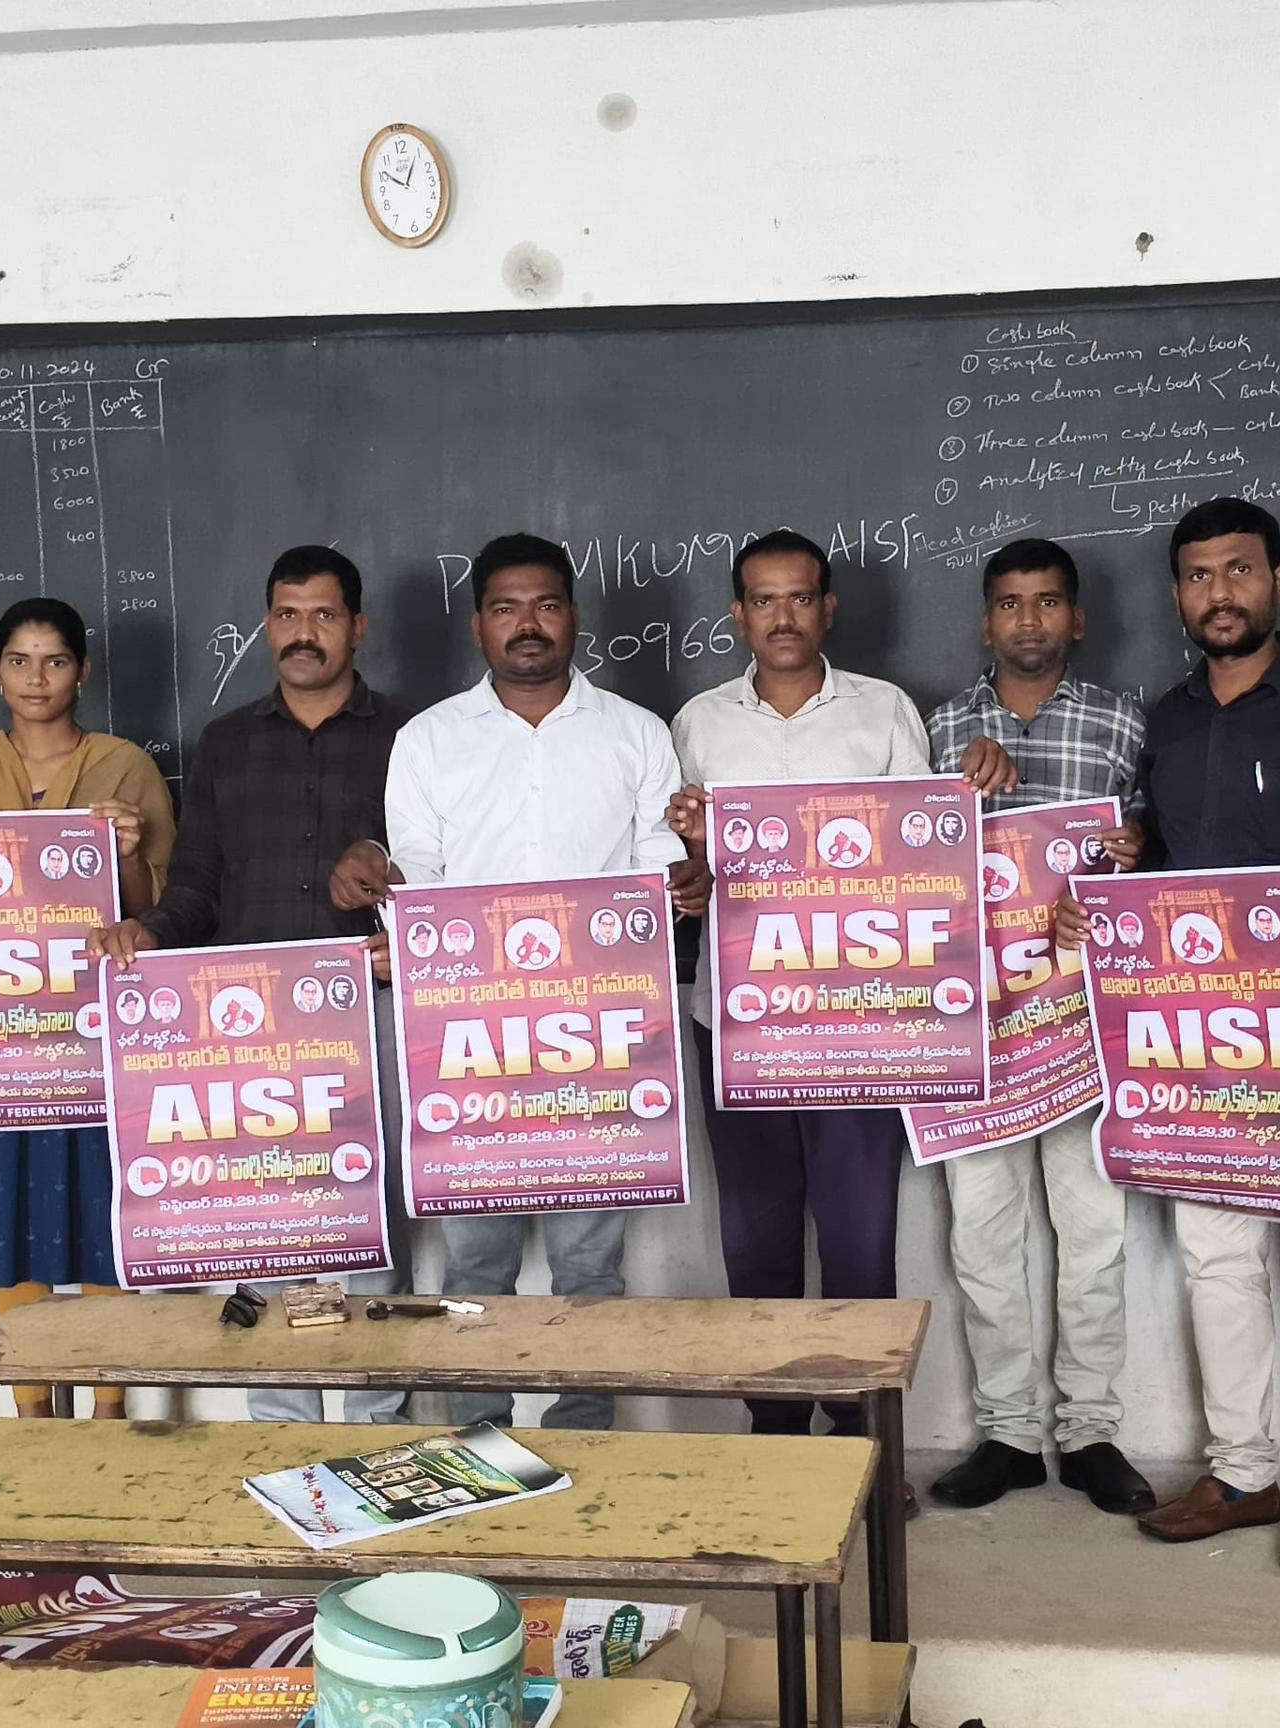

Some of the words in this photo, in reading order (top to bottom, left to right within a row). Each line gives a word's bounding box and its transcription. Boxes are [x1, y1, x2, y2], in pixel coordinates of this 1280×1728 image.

[395, 140, 406, 154] 12
[429, 176, 436, 187] 3
[380, 186, 386, 197] 9
[384, 200, 390, 210] 8
[426, 208, 432, 219] 5
[393, 214, 398, 225] 7
[411, 219, 418, 232] 6
[748, 909, 951, 971] AISF
[470, 981, 525, 1005] భారత
[770, 984, 814, 1015] 90
[438, 1008, 645, 1080] AISF
[1053, 1072, 1102, 1106] FEDERAT
[1151, 1083, 1188, 1114] 90
[147, 1074, 346, 1144] AISF
[462, 1091, 507, 1124] 90
[171, 1157, 215, 1187] 90
[214, 1683, 313, 1692] INTERac
[208, 1693, 316, 1707] ENGLIS
